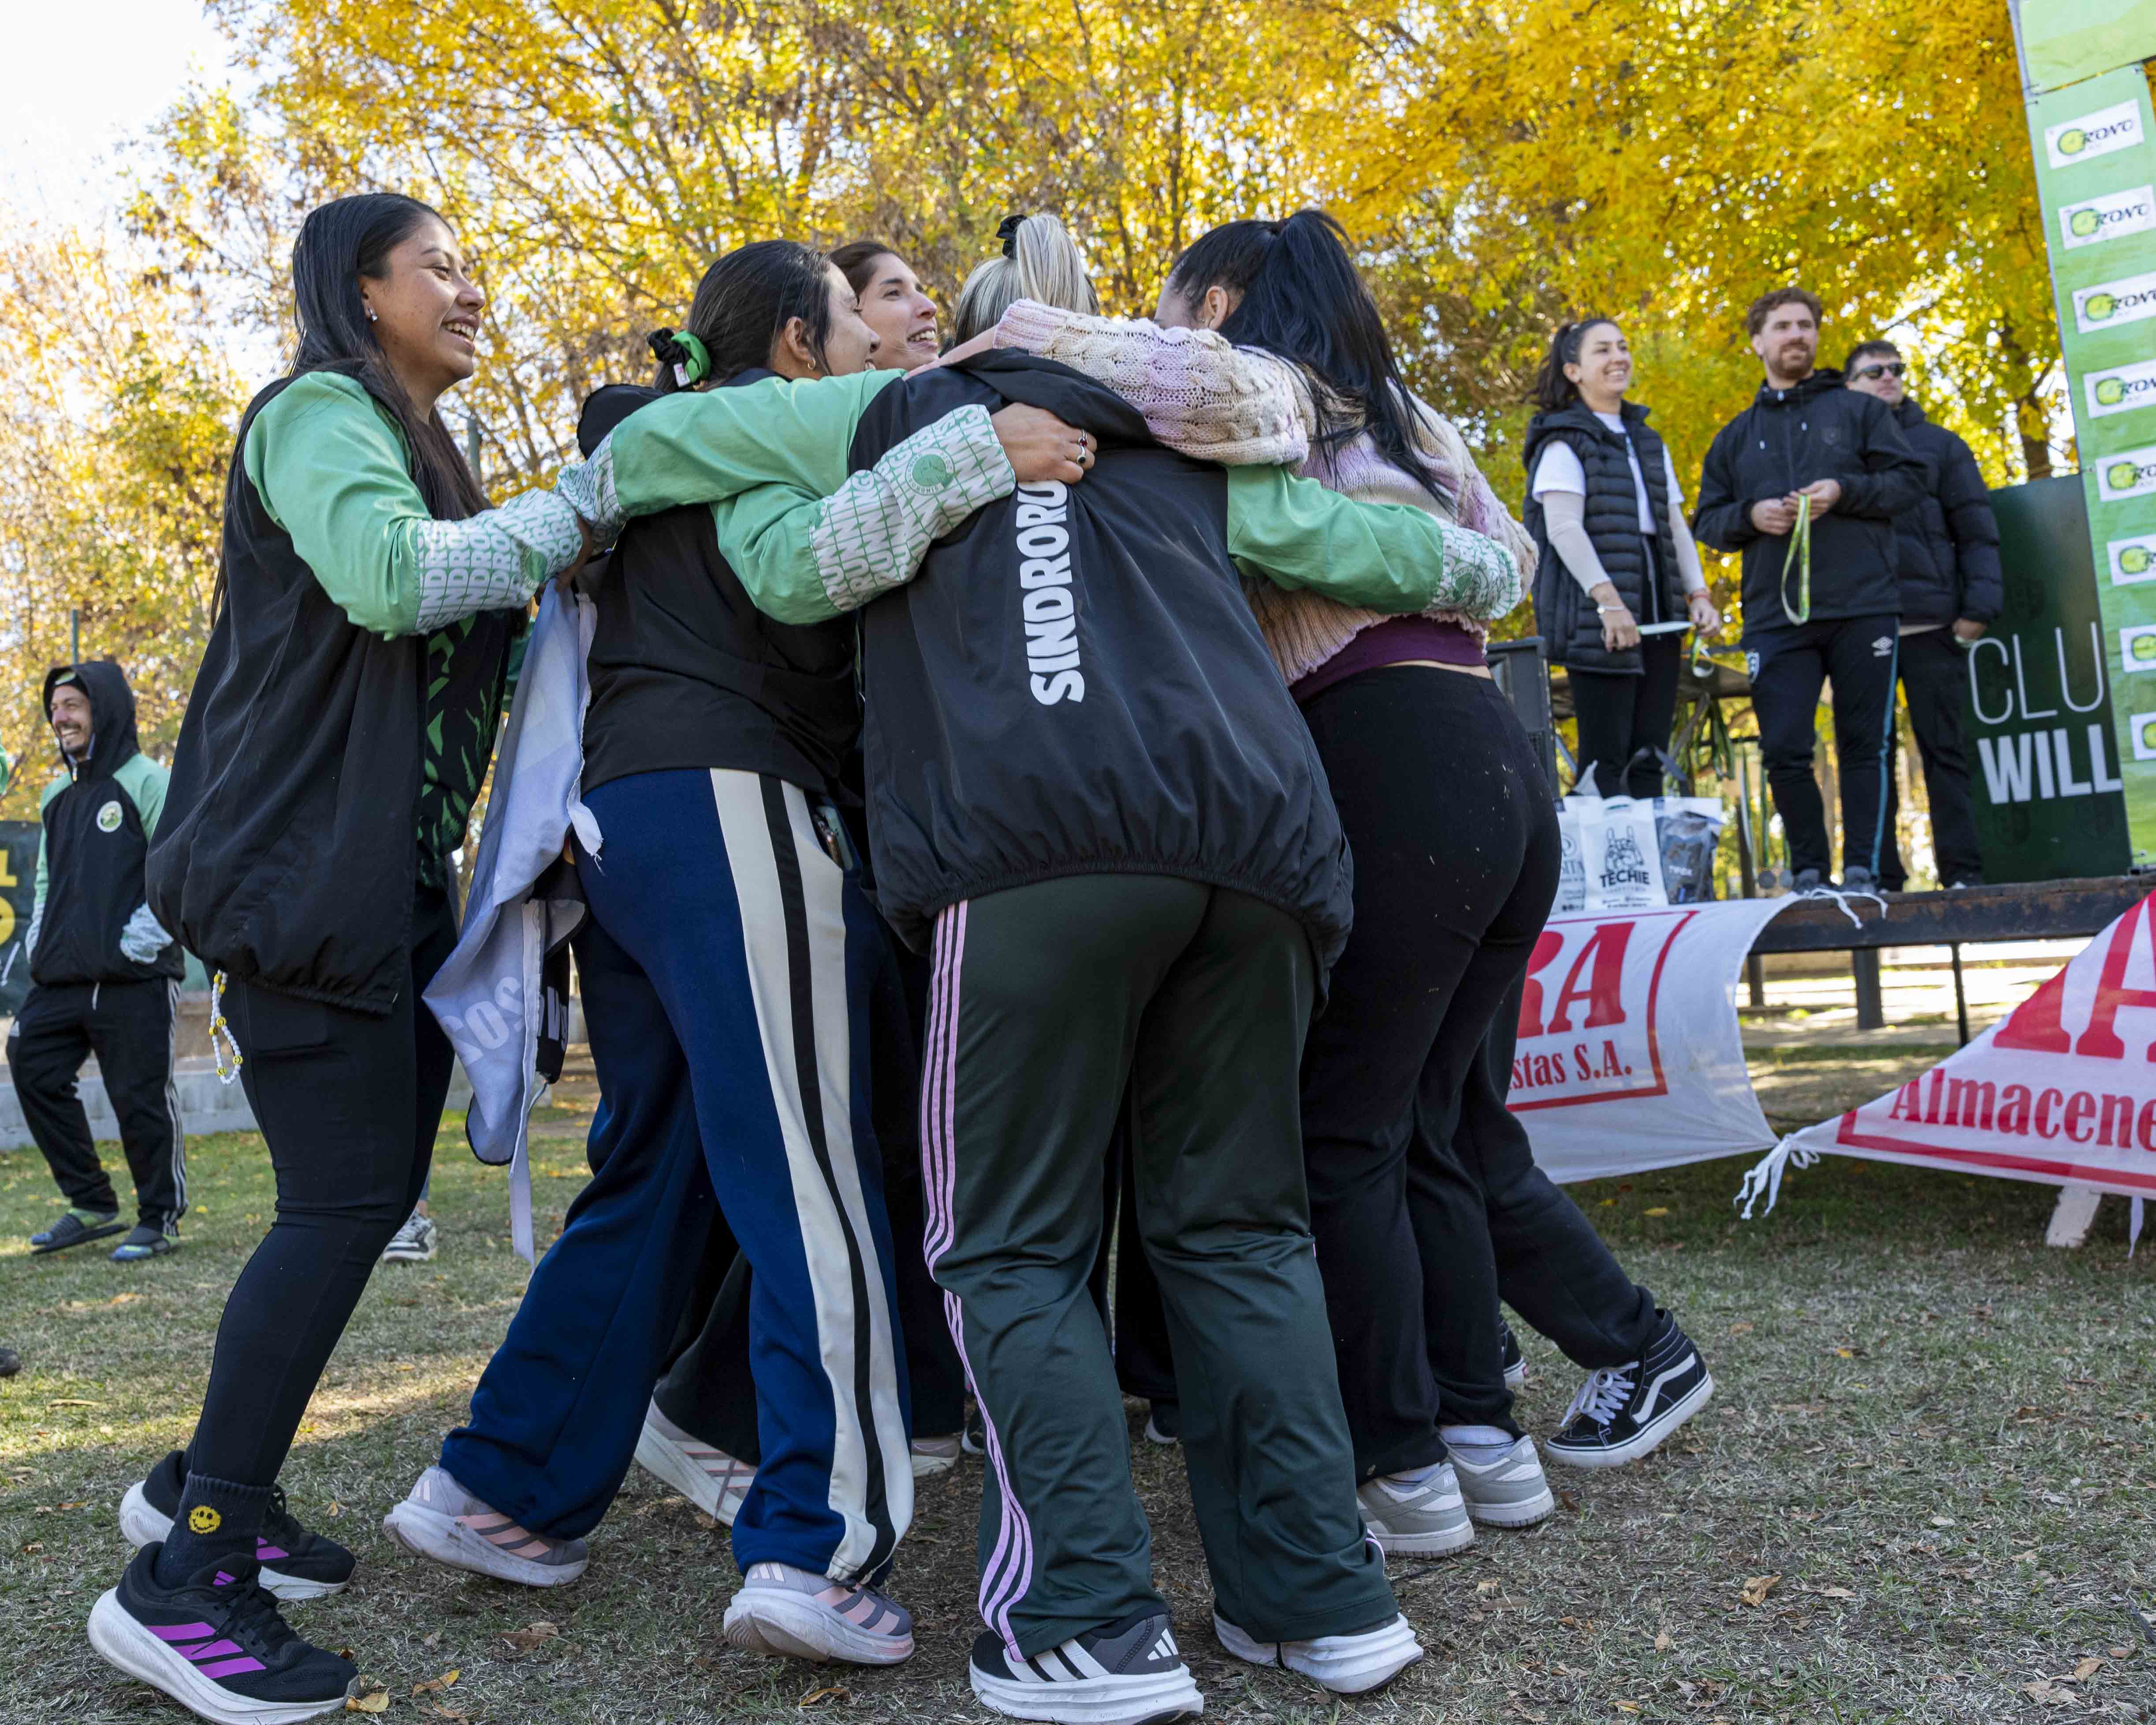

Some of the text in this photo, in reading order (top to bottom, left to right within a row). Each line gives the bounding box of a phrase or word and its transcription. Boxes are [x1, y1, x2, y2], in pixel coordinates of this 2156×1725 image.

[1968, 621, 2104, 724] CLU
[1977, 723, 2122, 805] WILL
[1600, 869, 1650, 887] TECHIE
[1509, 1039, 1632, 1090] stas S.A.
